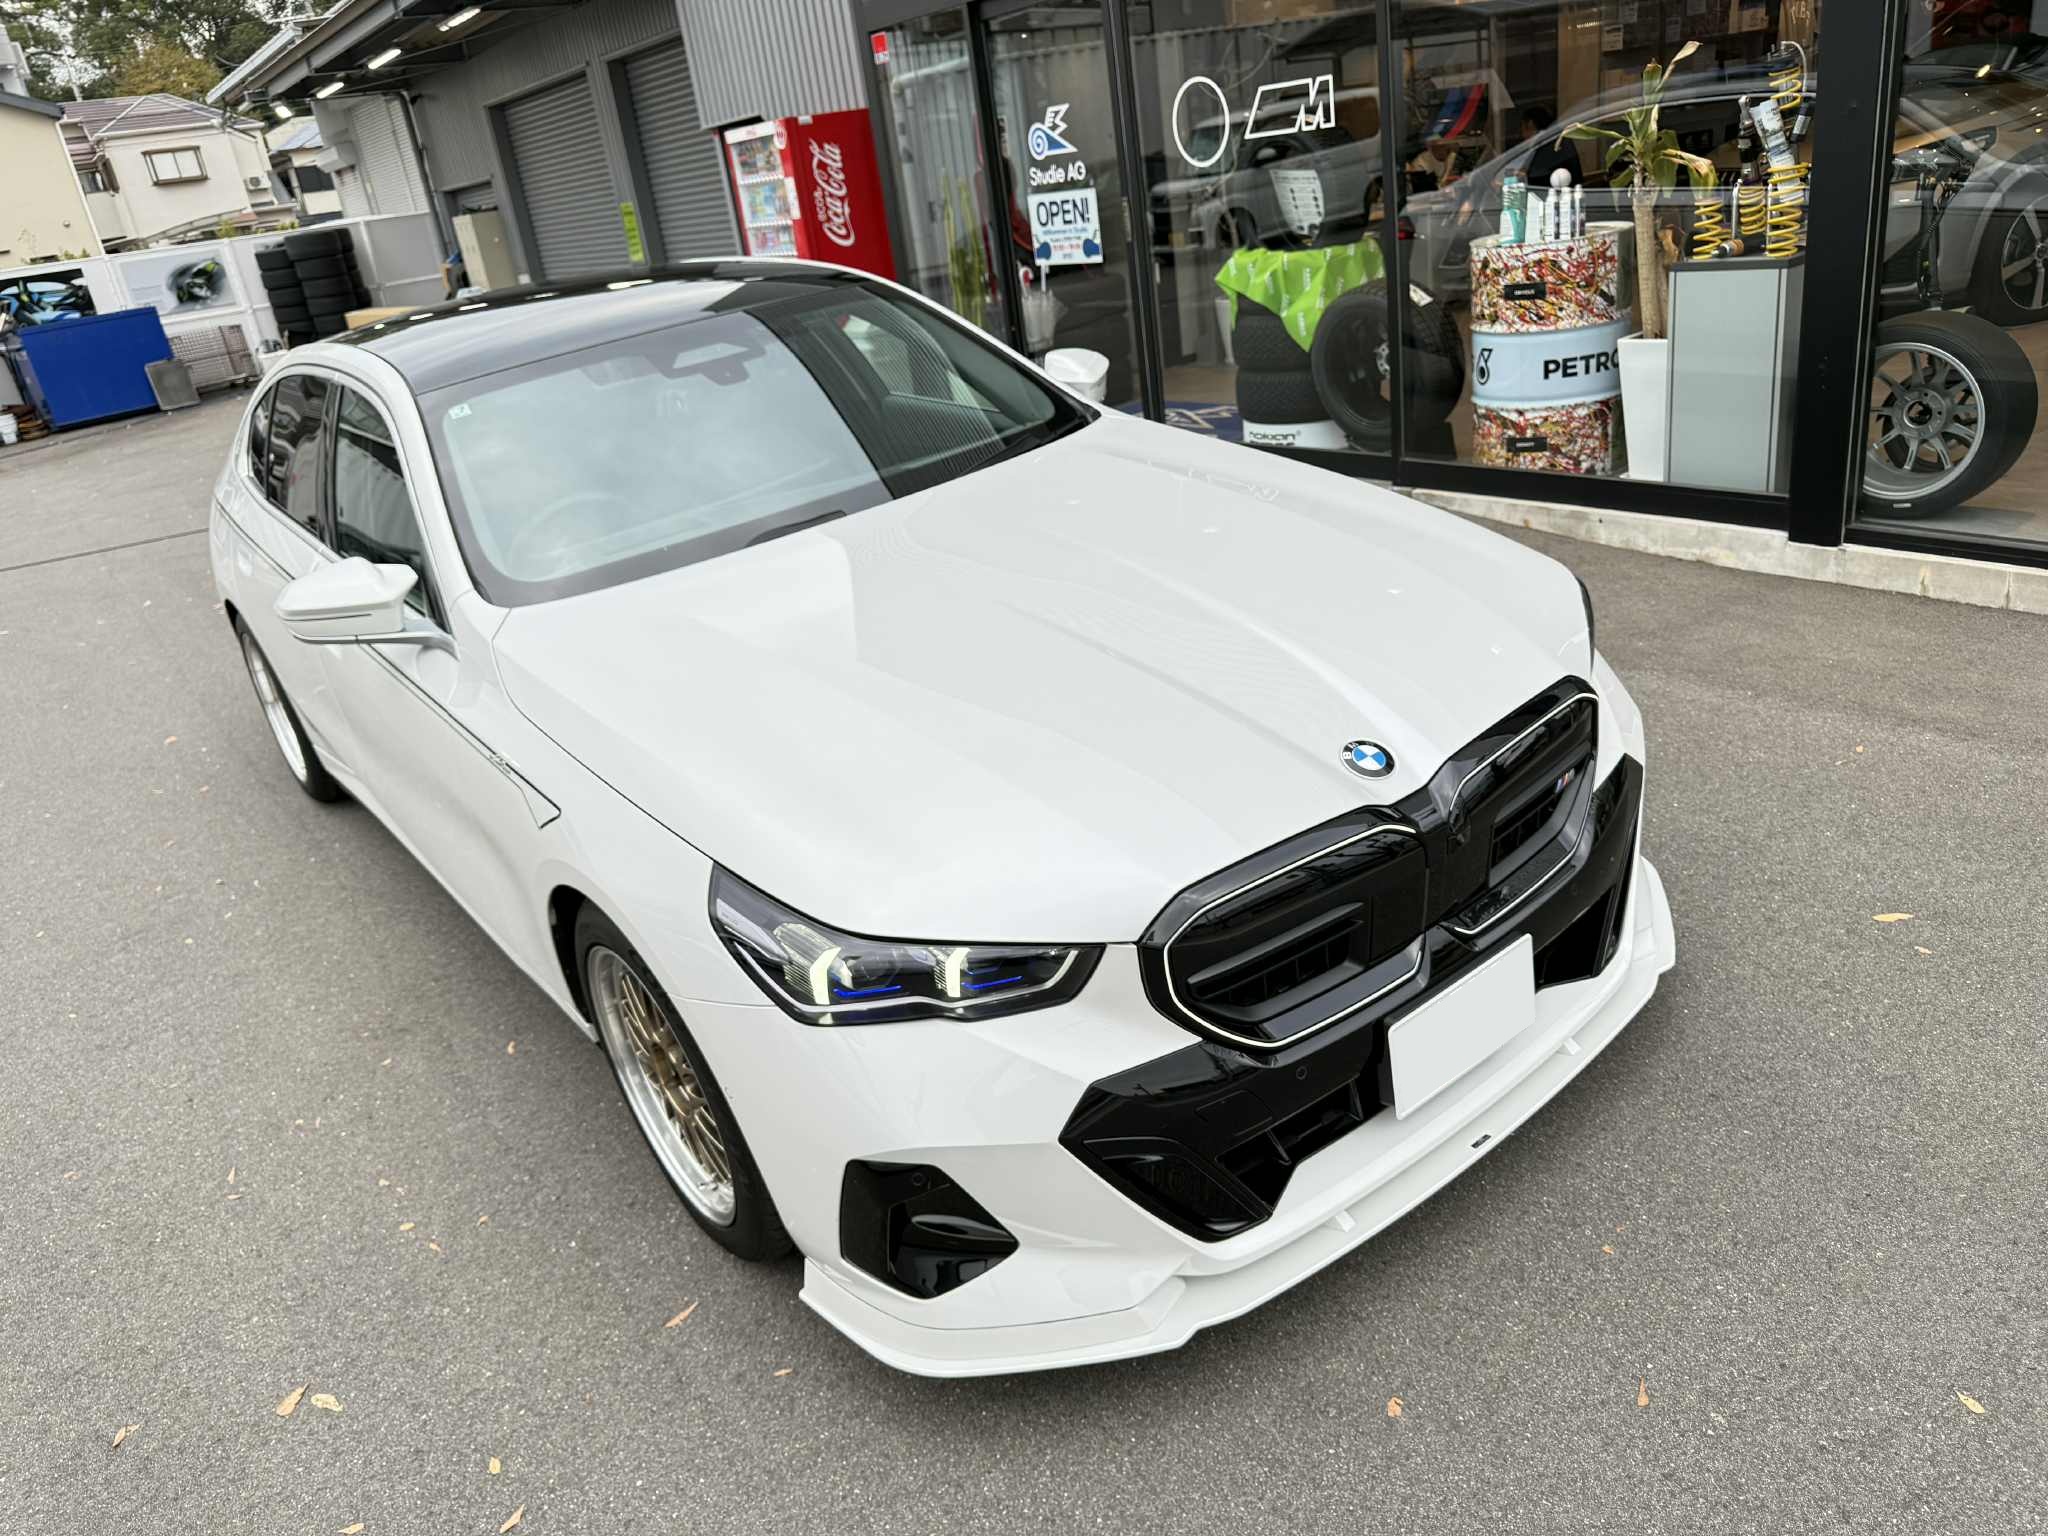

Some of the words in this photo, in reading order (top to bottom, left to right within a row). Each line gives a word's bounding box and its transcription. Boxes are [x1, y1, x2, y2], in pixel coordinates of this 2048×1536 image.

[1029, 163, 1065, 186] Studie
[1067, 160, 1087, 182] AG
[808, 138, 856, 247] Coca-Cola
[1037, 197, 1090, 227] OPEN!
